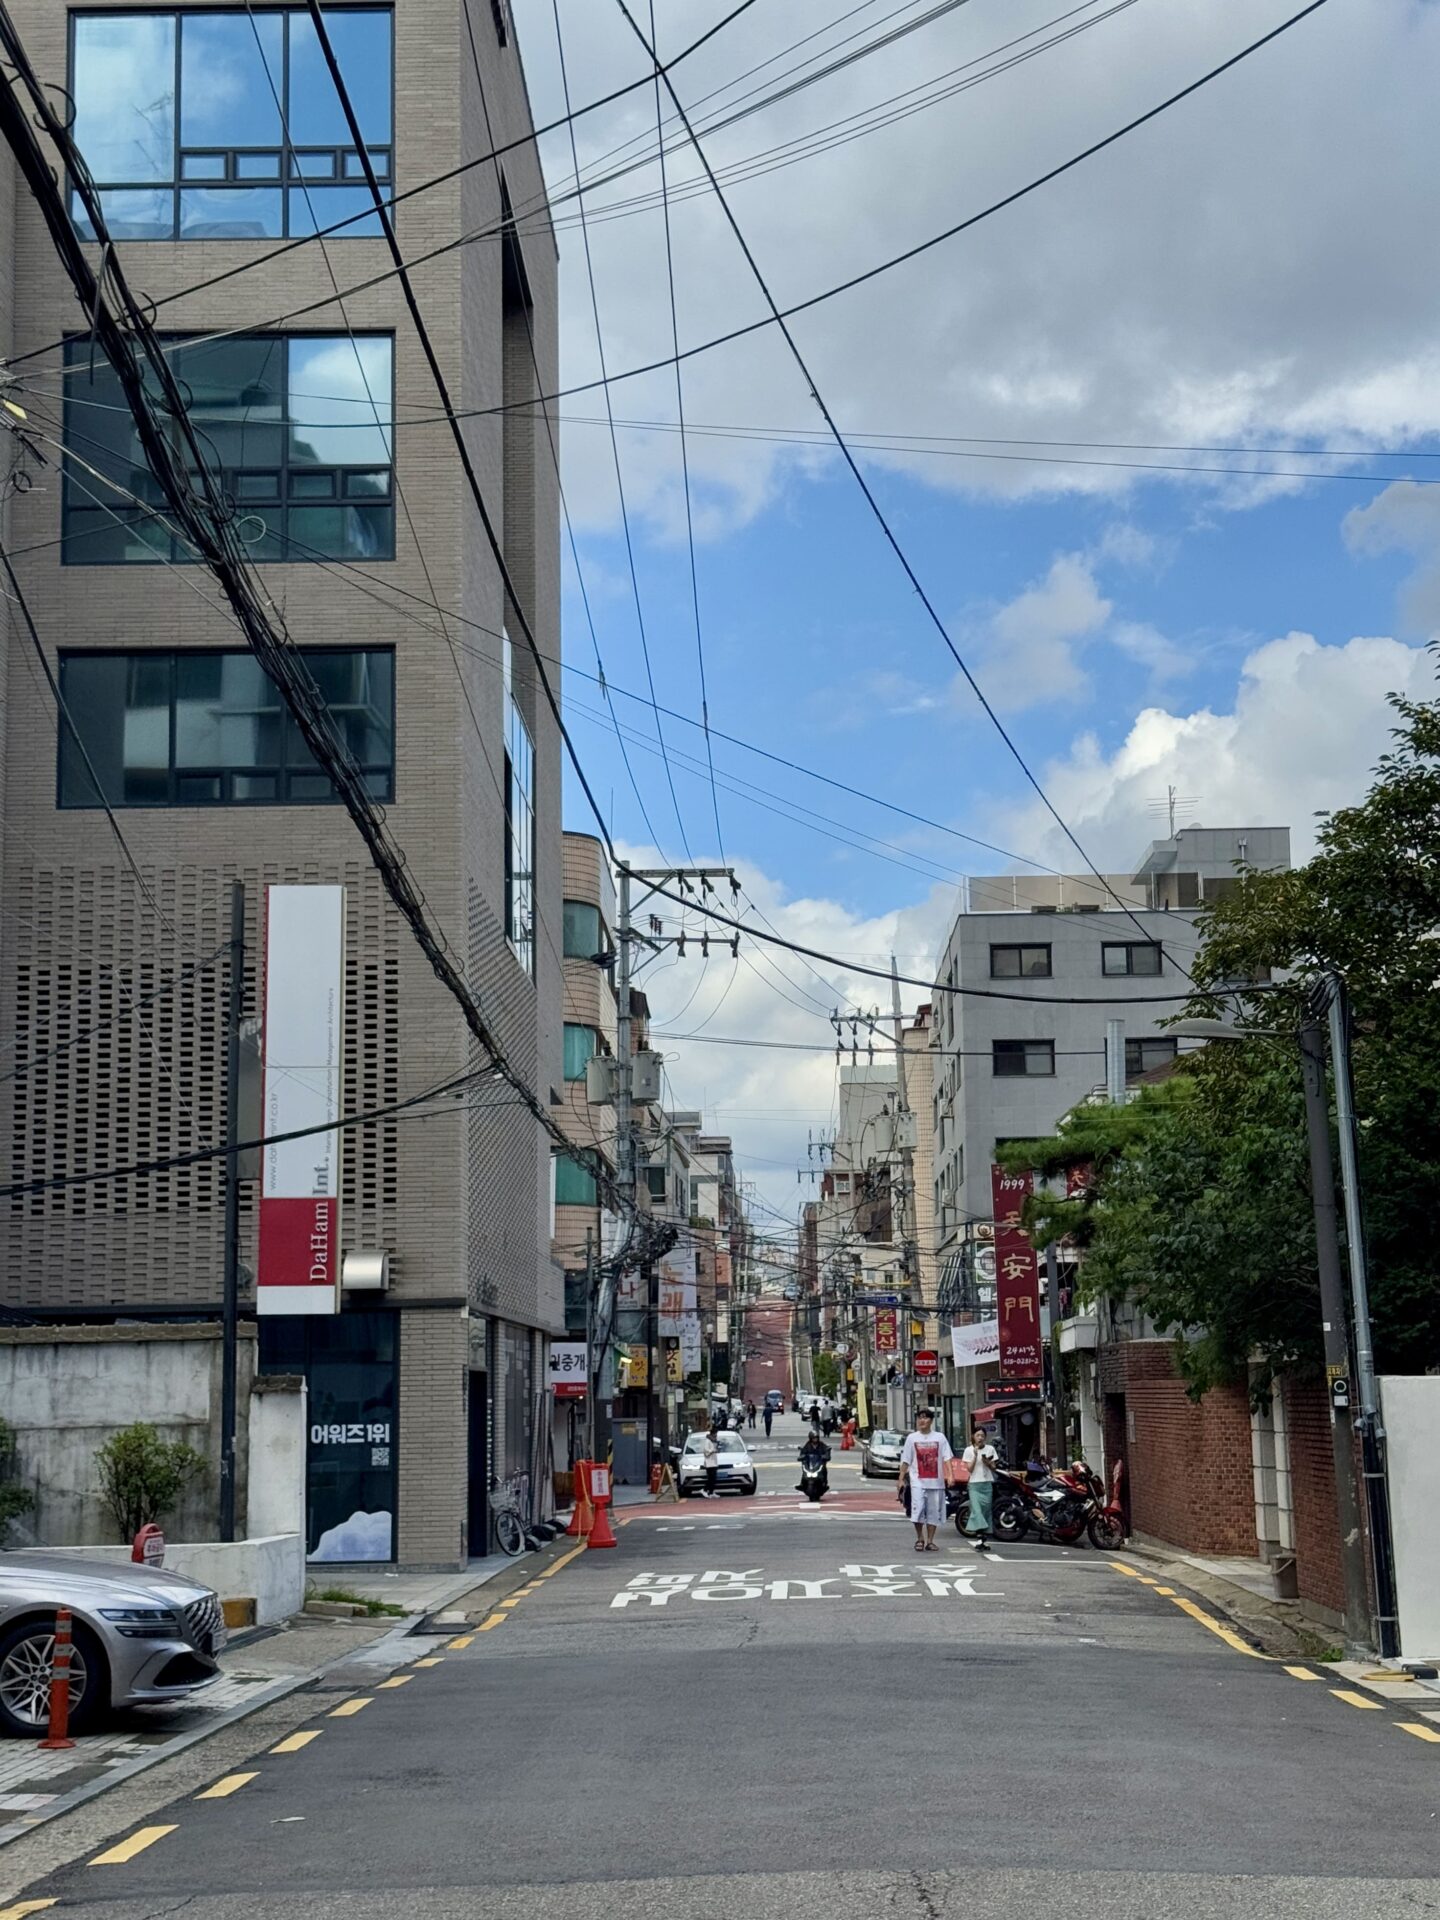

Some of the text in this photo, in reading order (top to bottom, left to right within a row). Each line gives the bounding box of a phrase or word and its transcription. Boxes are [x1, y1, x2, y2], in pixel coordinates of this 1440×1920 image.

[999, 1178, 1026, 1191] 1999
[309, 1156, 330, 1281] DaHam Int.
[609, 1578, 1005, 1608] 거주자우선
